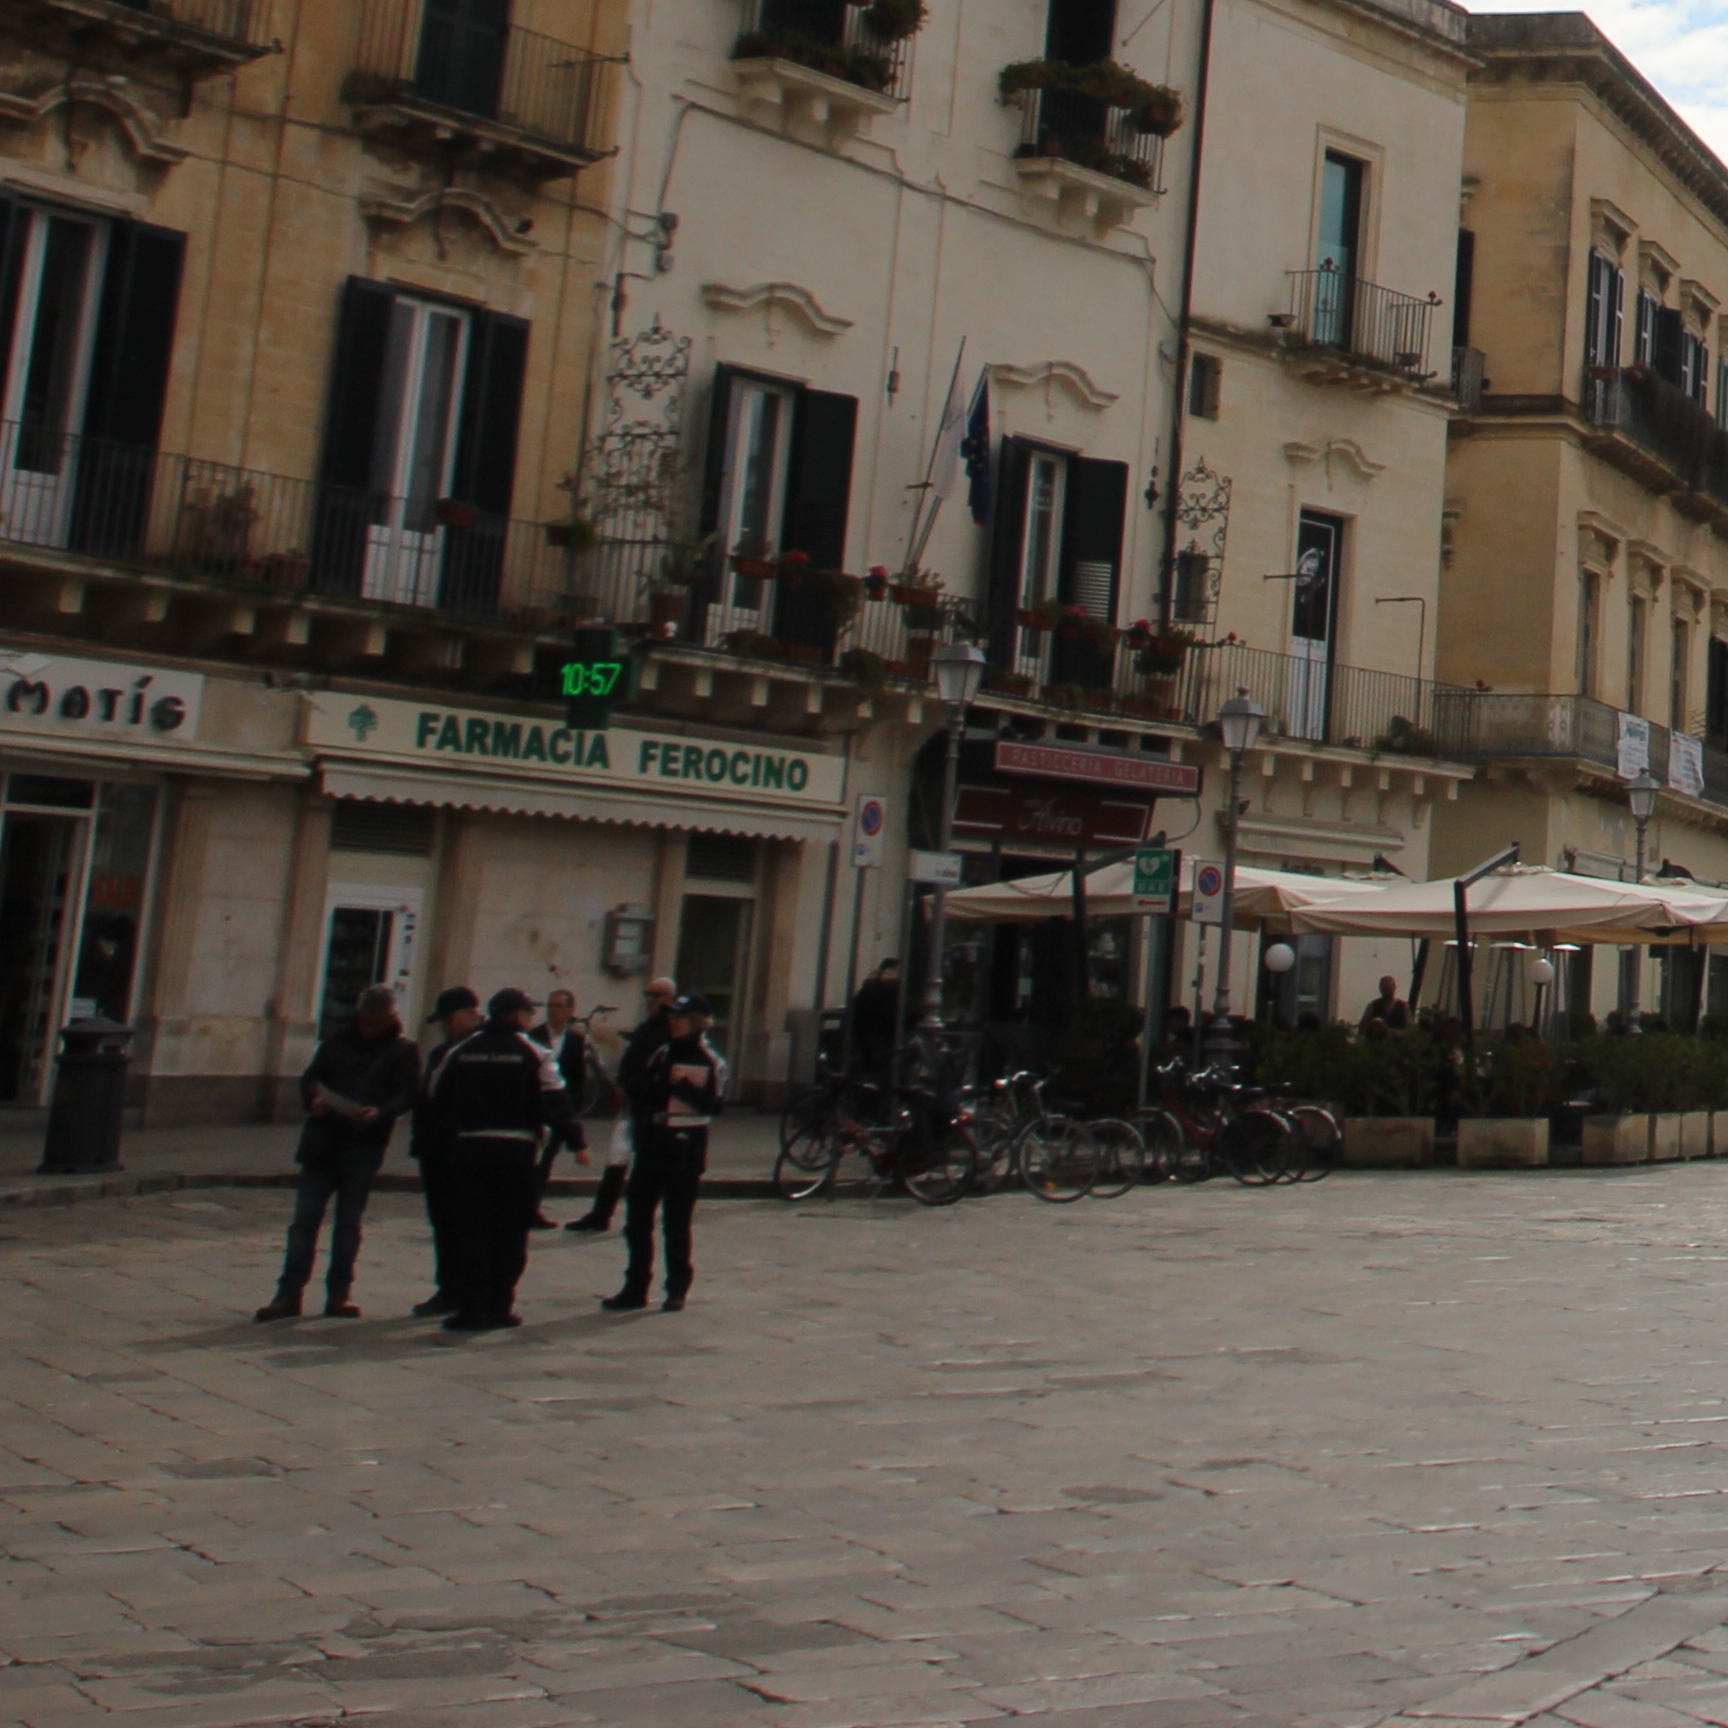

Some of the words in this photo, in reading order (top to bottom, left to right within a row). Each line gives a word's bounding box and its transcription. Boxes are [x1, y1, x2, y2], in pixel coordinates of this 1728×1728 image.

[561, 663, 622, 696] 10:57
[416, 712, 610, 769] FARMACIA
[638, 739, 809, 791] FEROCINO
[1011, 749, 1102, 773] PASTICCERIA
[1115, 761, 1184, 784] GELATERIA
